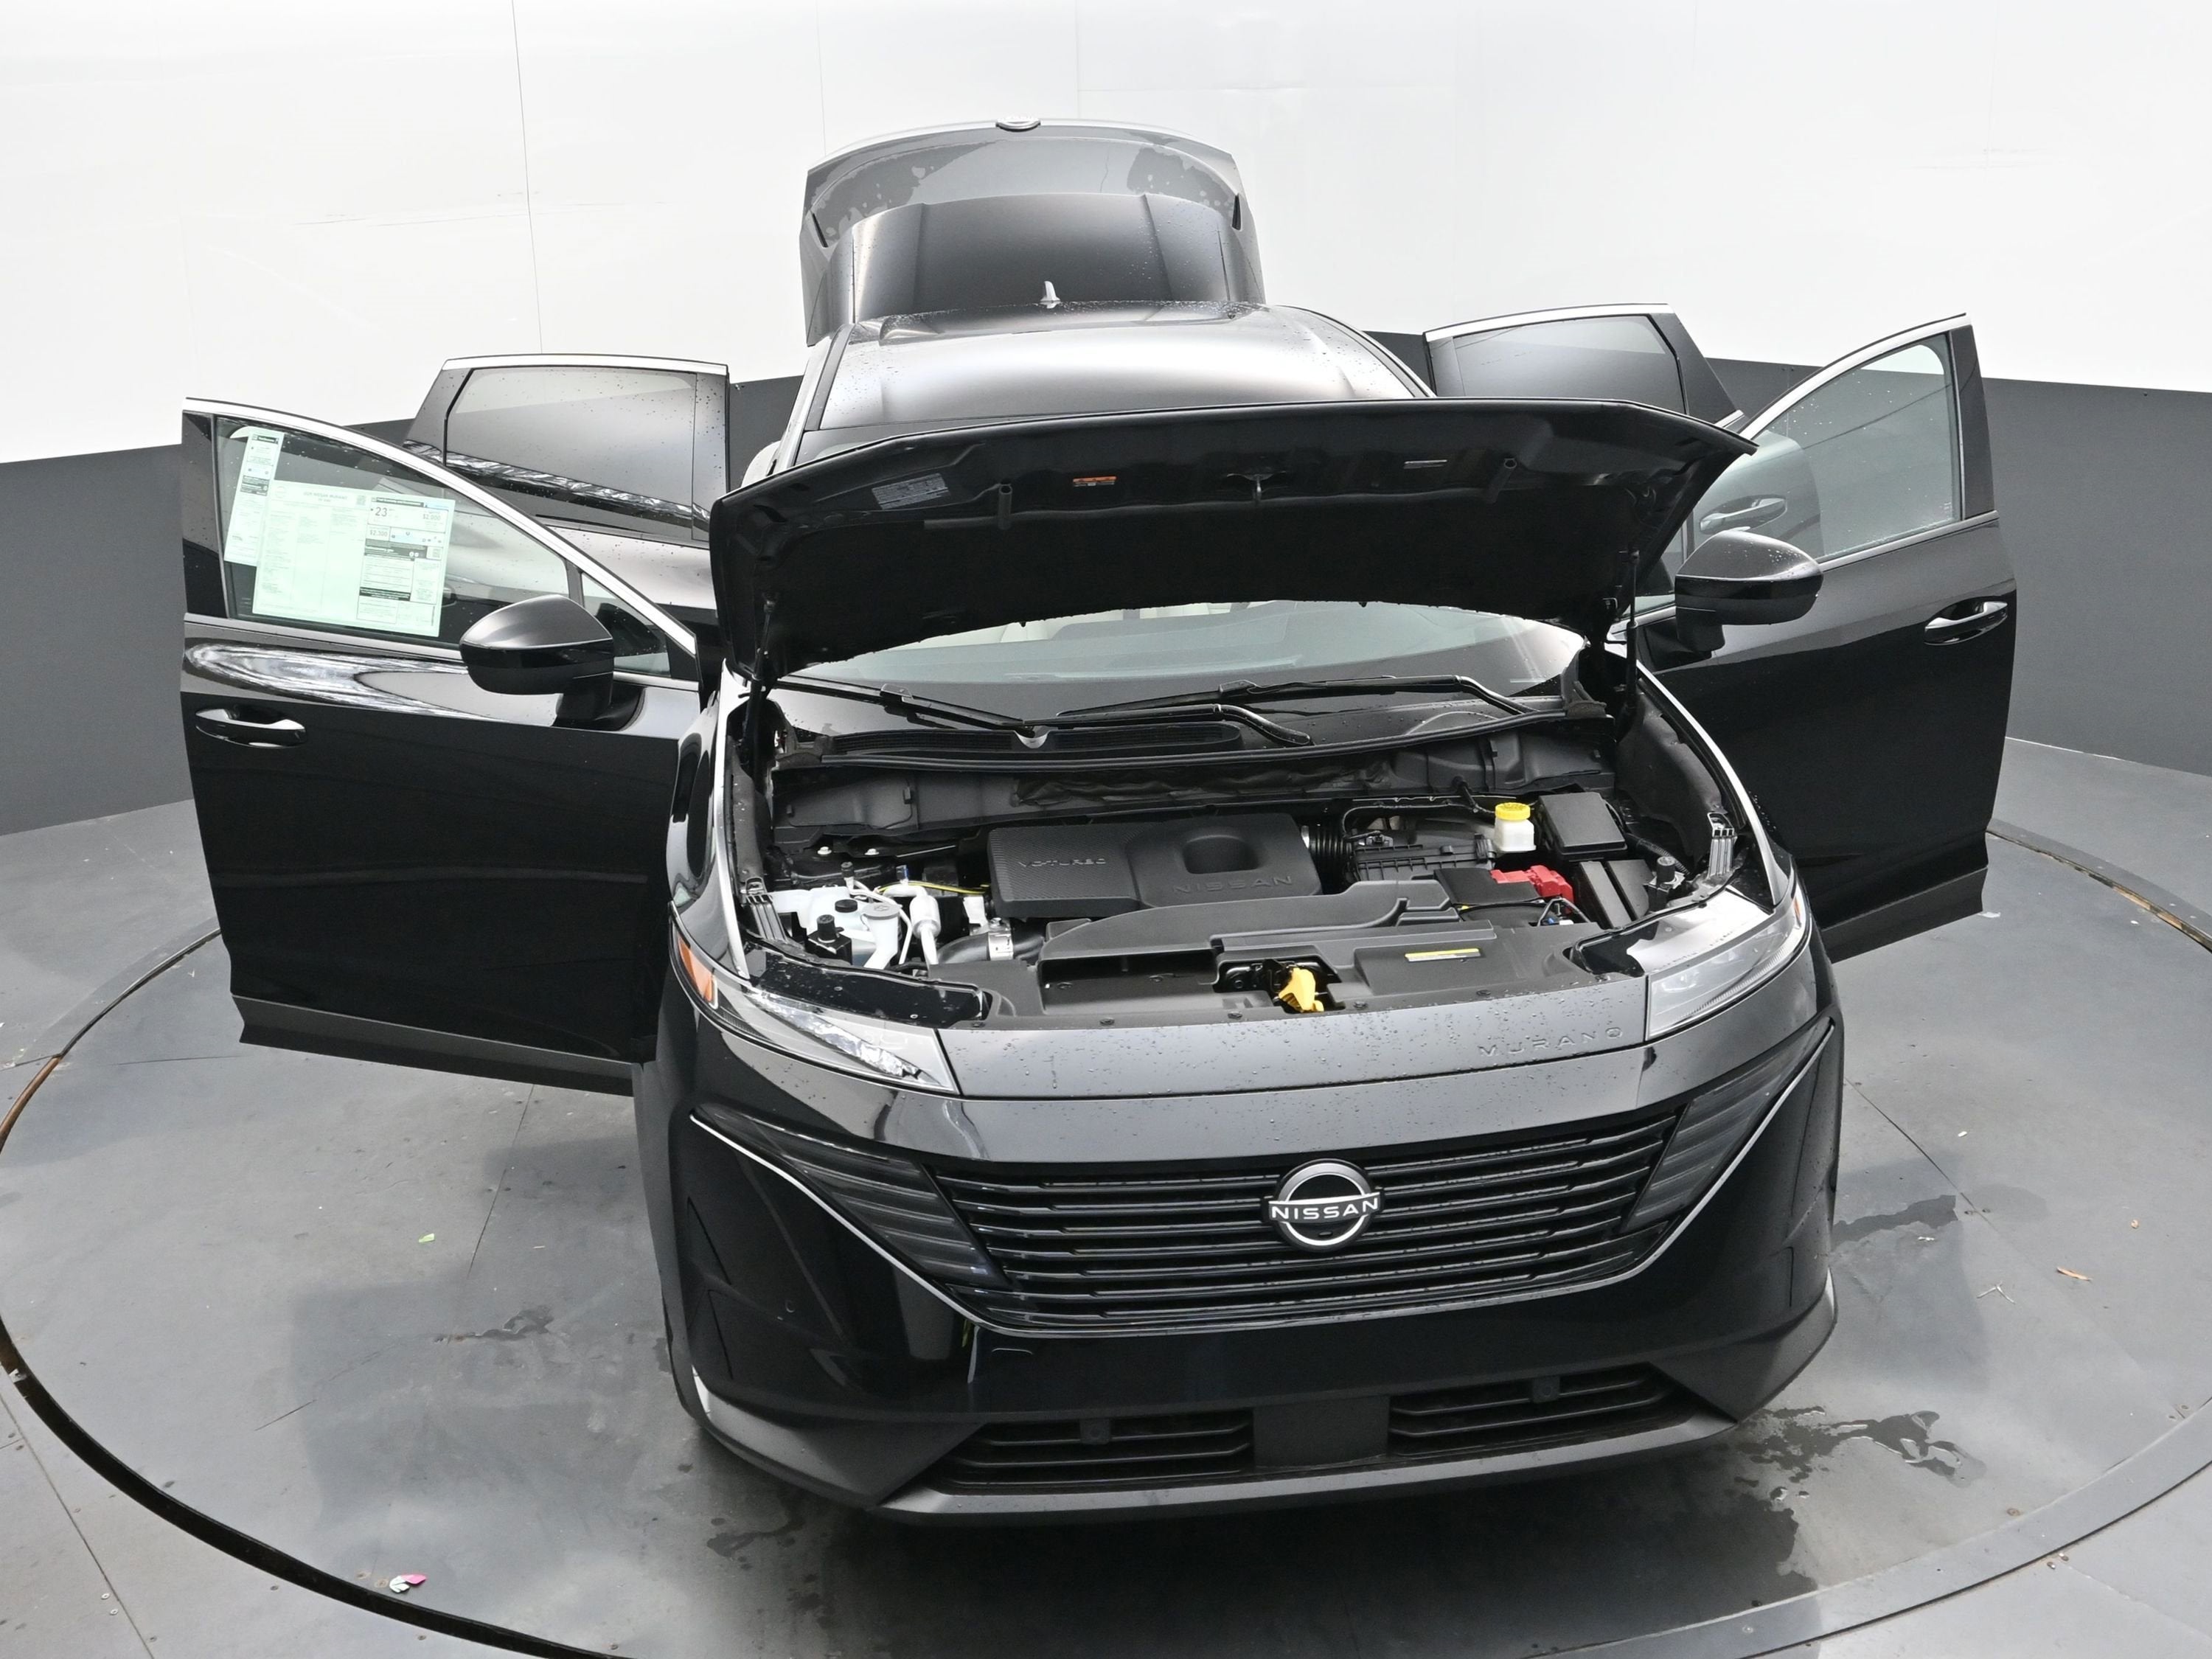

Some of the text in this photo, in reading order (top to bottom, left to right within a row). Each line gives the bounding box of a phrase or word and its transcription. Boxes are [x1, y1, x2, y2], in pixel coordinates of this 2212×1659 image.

[375, 507, 388, 518] 23
[1172, 876, 1293, 894] NISSAN
[1477, 1026, 1624, 1057] MURANO
[1271, 1197, 1379, 1220] NISSAN
